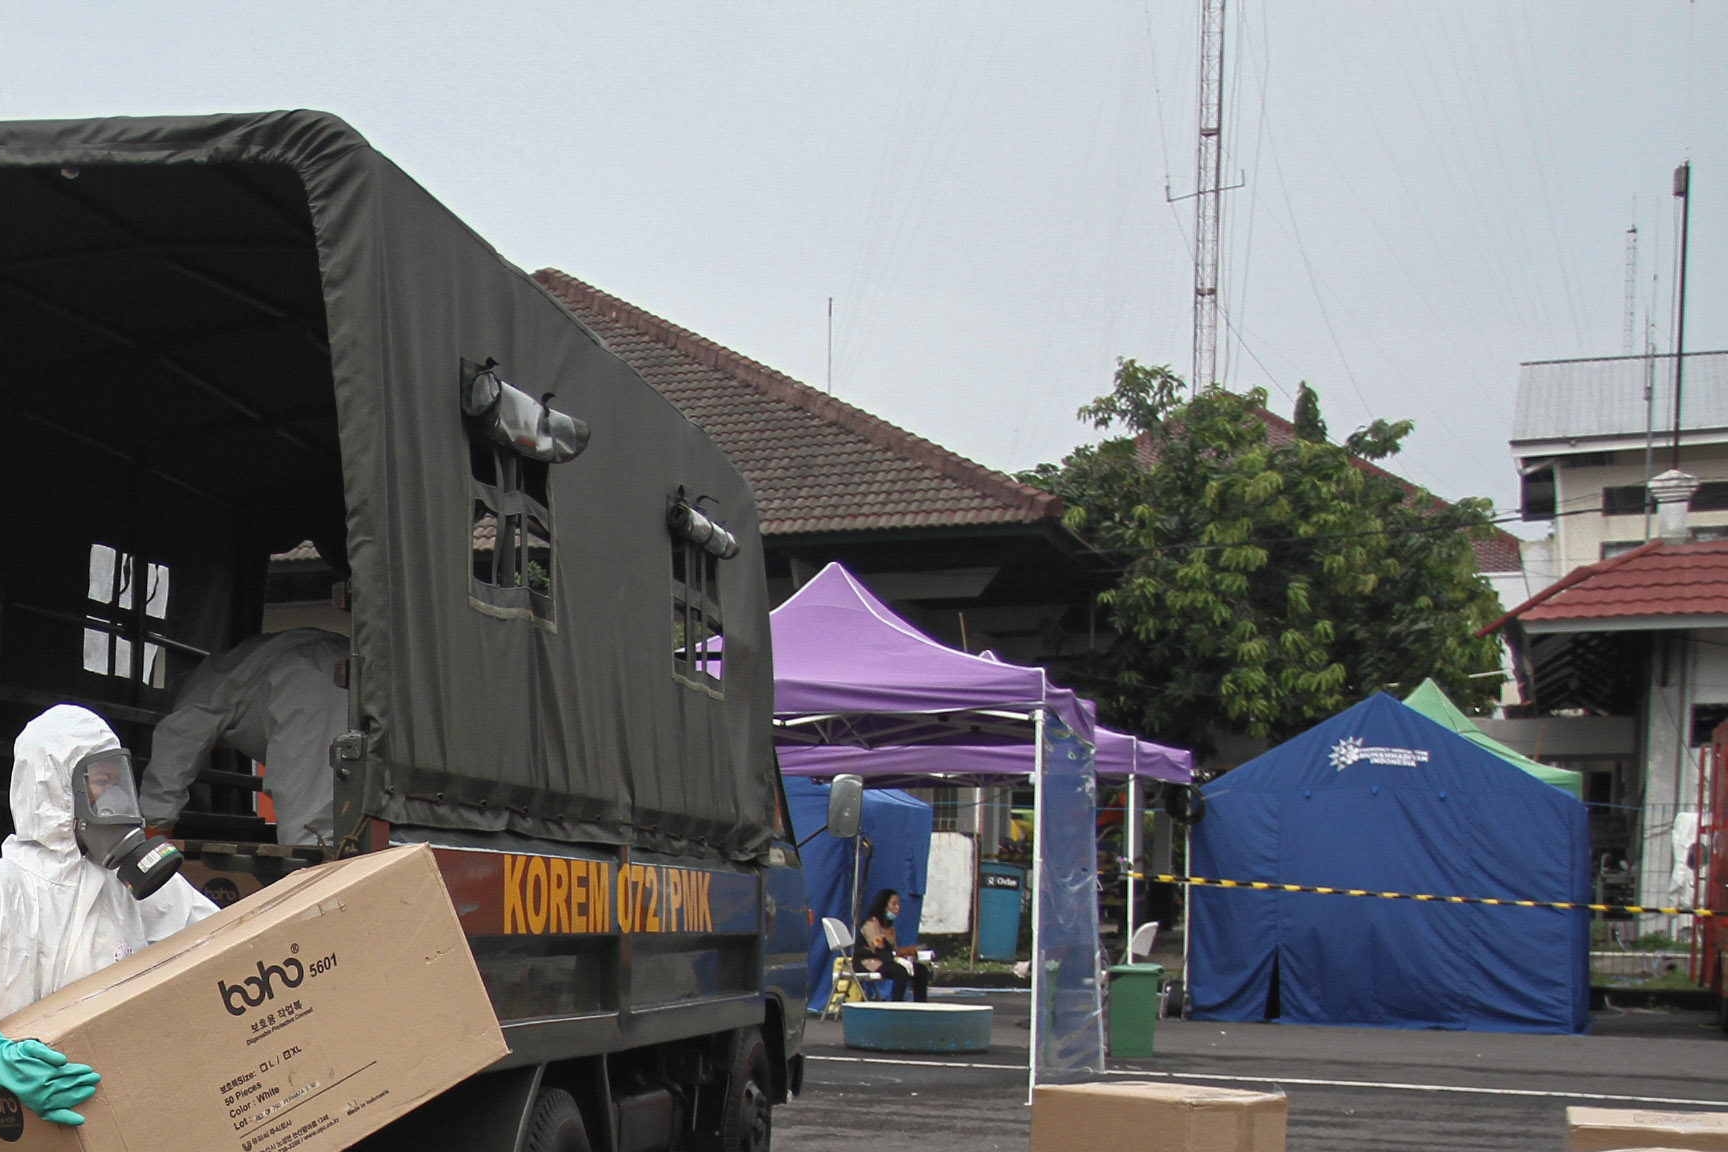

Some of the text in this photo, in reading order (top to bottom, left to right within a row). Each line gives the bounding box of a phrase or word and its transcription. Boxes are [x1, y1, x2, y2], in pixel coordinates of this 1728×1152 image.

[503, 854, 610, 934] KOREM
[217, 952, 338, 1016] boho 5601
[251, 1000, 302, 1034] 보호용 작업복
[291, 1045, 302, 1056] XL
[224, 1082, 262, 1106] 50 Pieces
[230, 1085, 280, 1119] Color White
[234, 1119, 249, 1131] Lot
